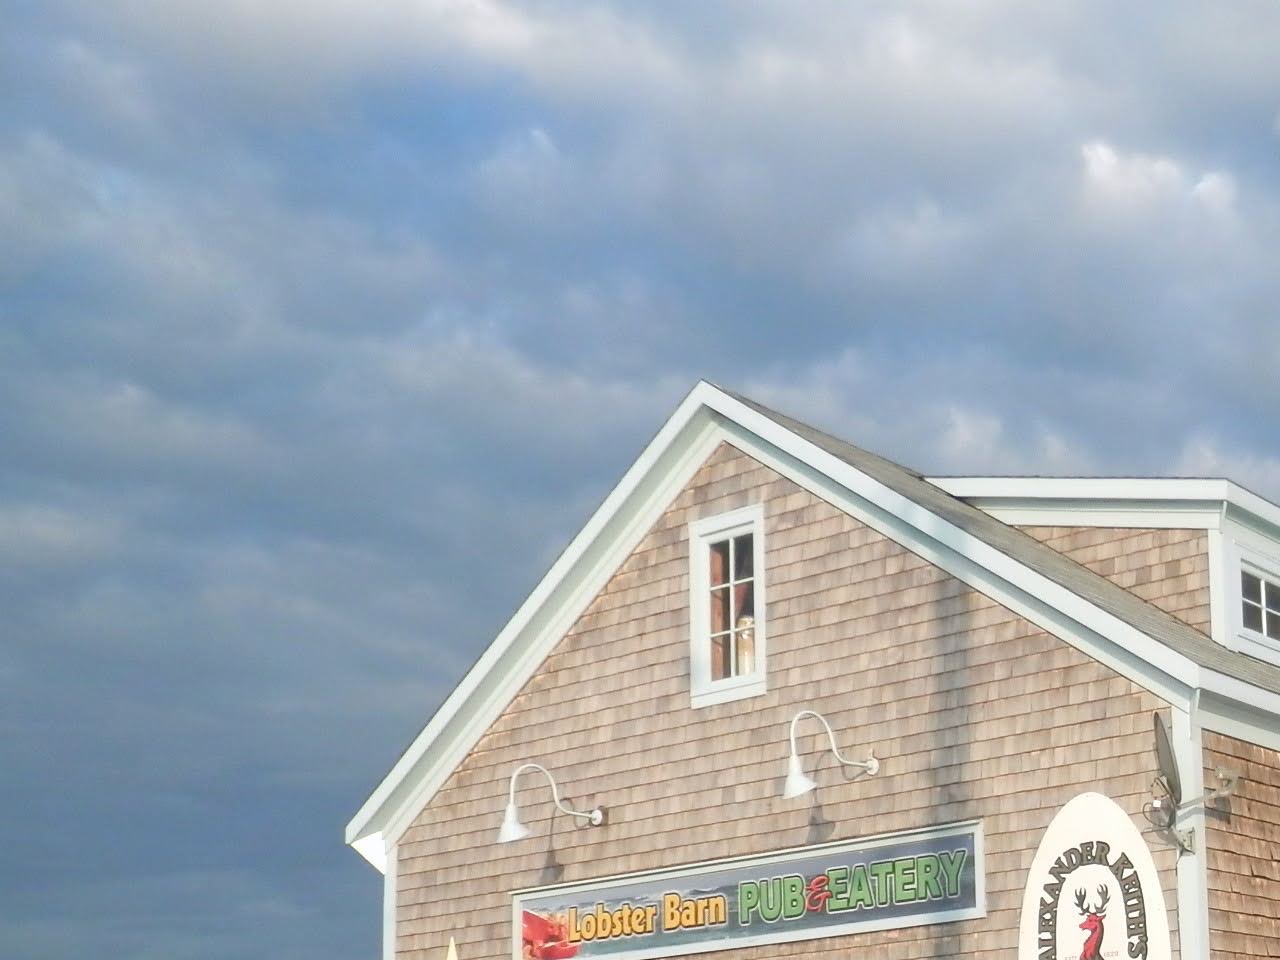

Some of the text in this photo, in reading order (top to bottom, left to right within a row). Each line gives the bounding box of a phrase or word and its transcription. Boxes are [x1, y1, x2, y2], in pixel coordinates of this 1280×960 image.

[567, 903, 656, 943] Lobster
[663, 893, 726, 931] Barn
[738, 876, 805, 925] PUB
[827, 850, 968, 914] EATERY
[1109, 852, 1148, 960] KEITH'S
